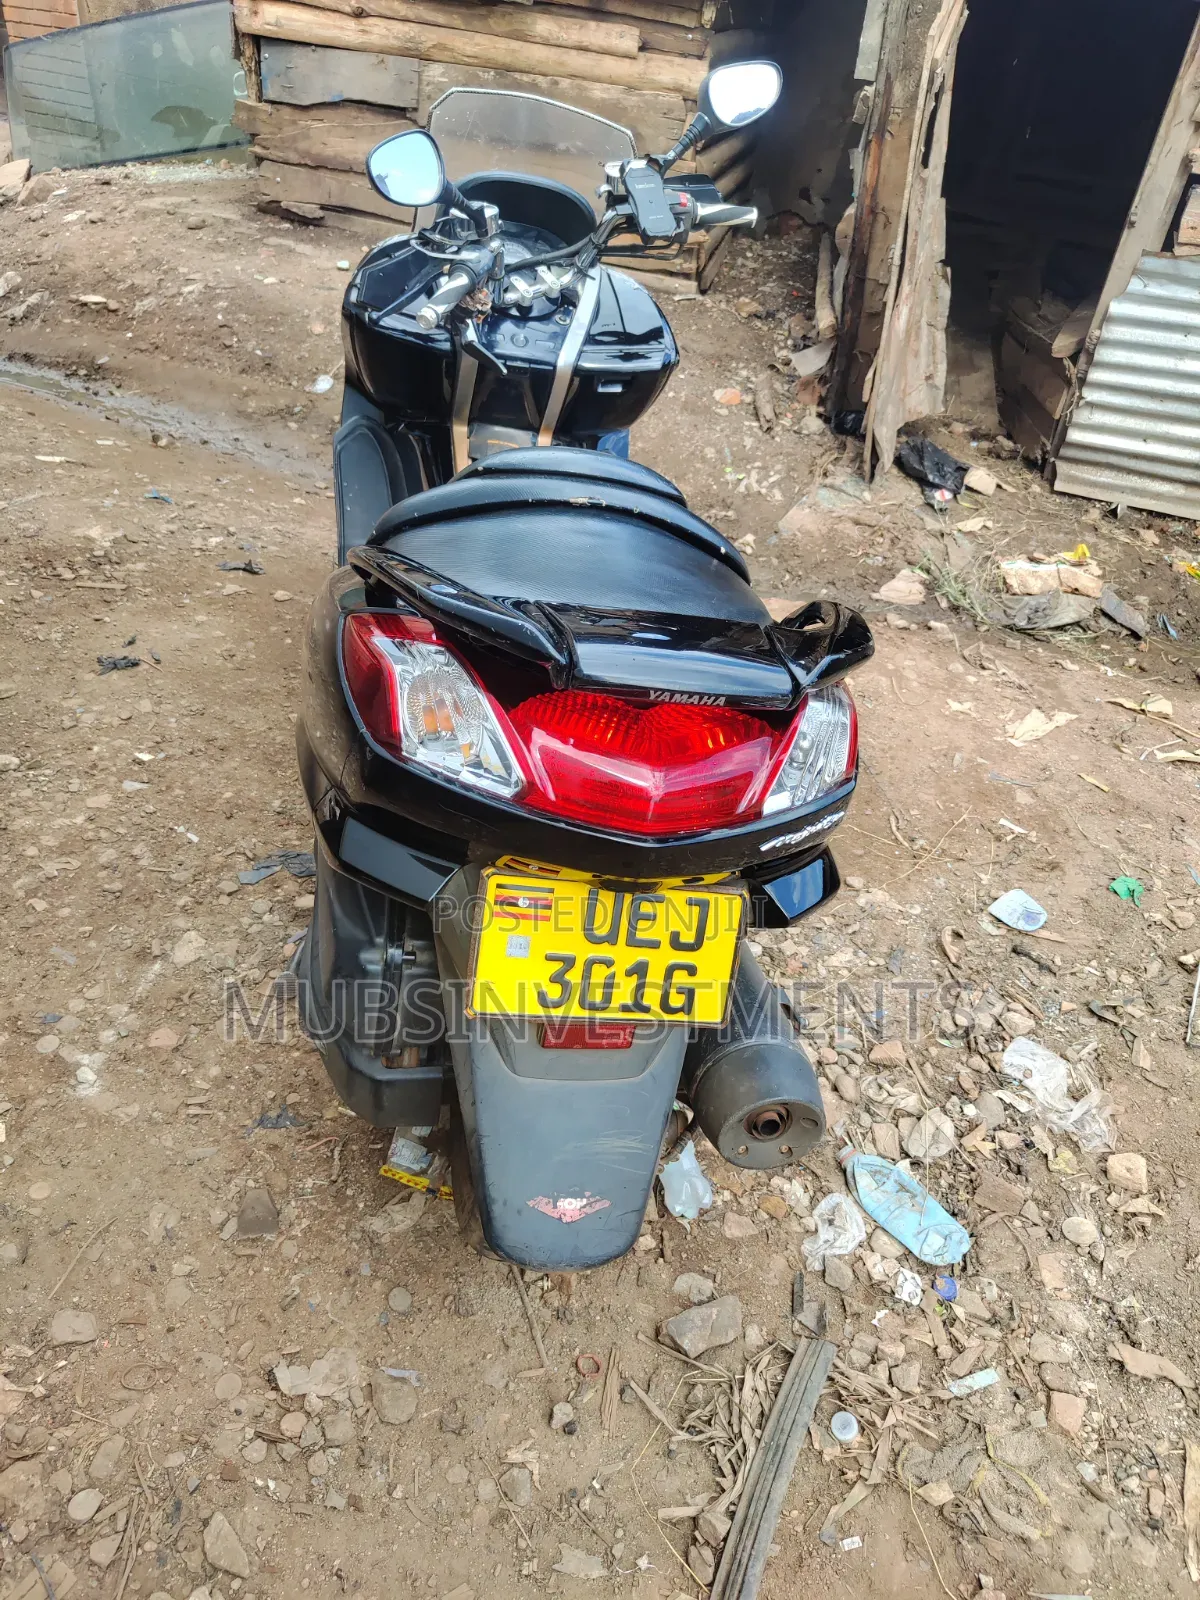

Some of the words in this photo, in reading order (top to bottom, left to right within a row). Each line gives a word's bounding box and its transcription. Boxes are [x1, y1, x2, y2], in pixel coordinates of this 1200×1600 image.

[648, 689, 726, 706] YAMAHA
[583, 887, 710, 952] UEJ
[537, 952, 698, 1015] 301G
